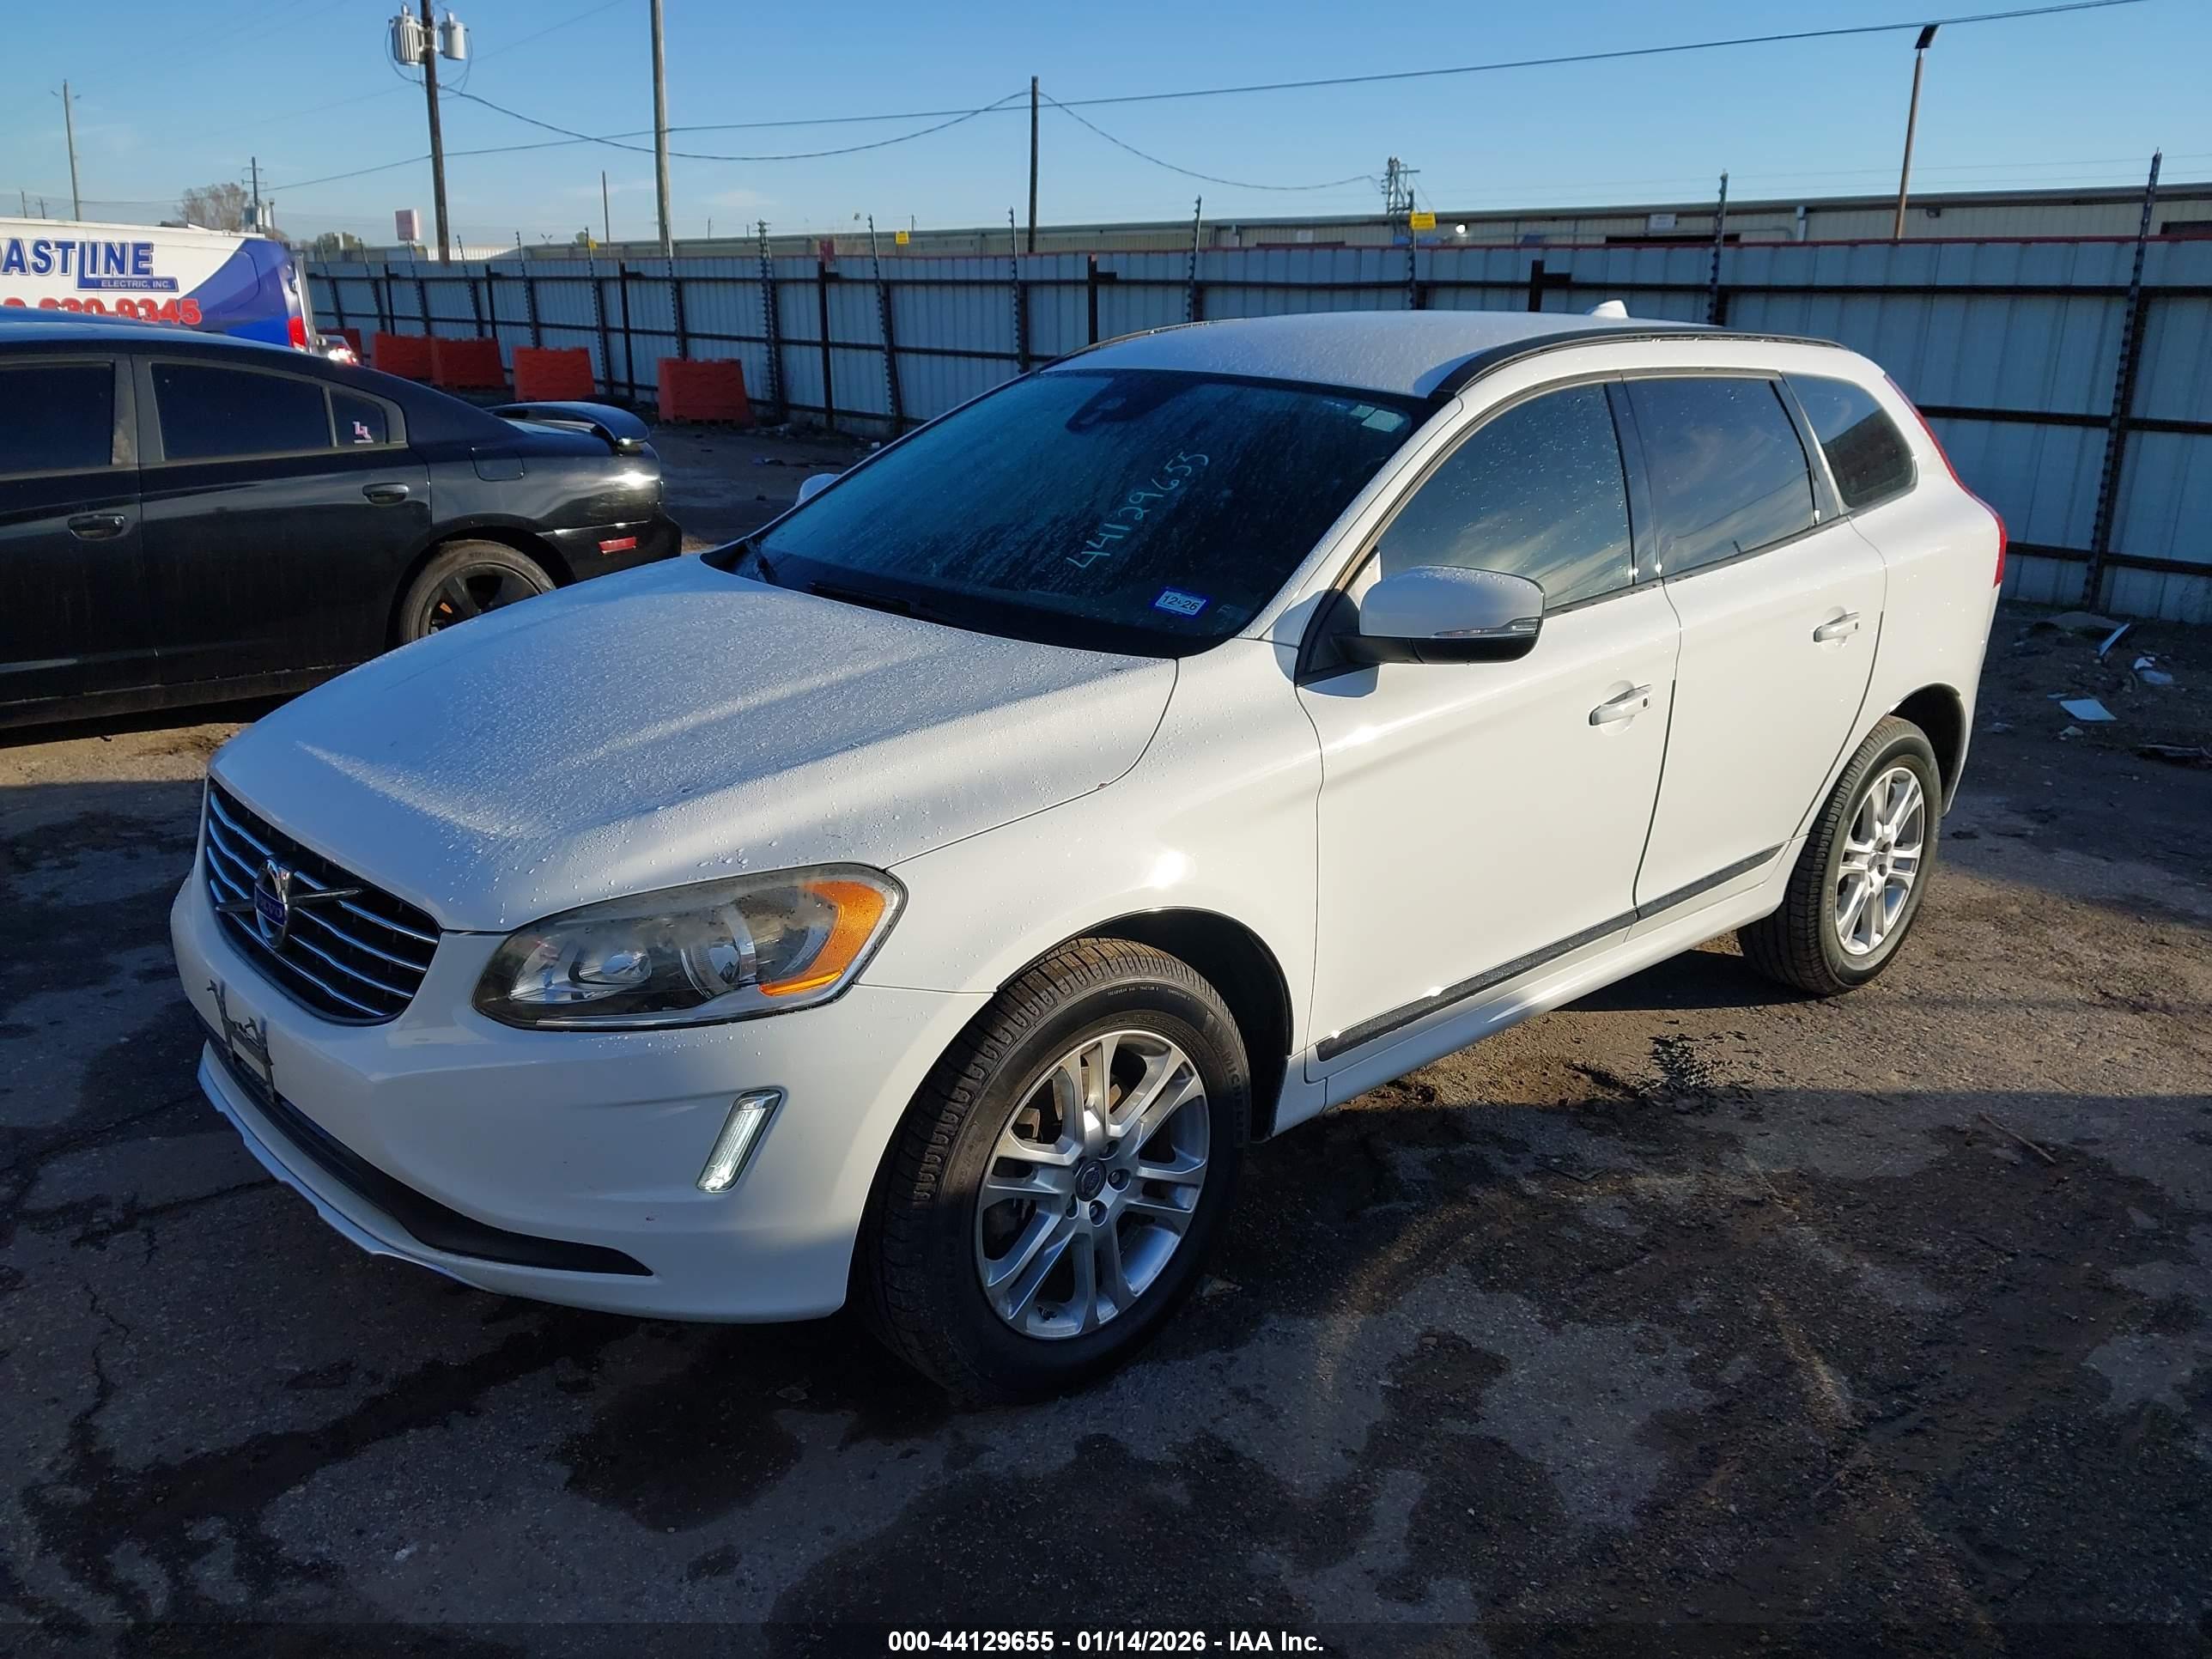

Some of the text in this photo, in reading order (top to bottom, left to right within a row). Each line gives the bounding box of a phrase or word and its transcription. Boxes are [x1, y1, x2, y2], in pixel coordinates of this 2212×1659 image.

[0, 238, 155, 280] ASTLINE
[100, 280, 172, 289] ELECTRIC, INC.
[1066, 451, 1209, 568] 44129655
